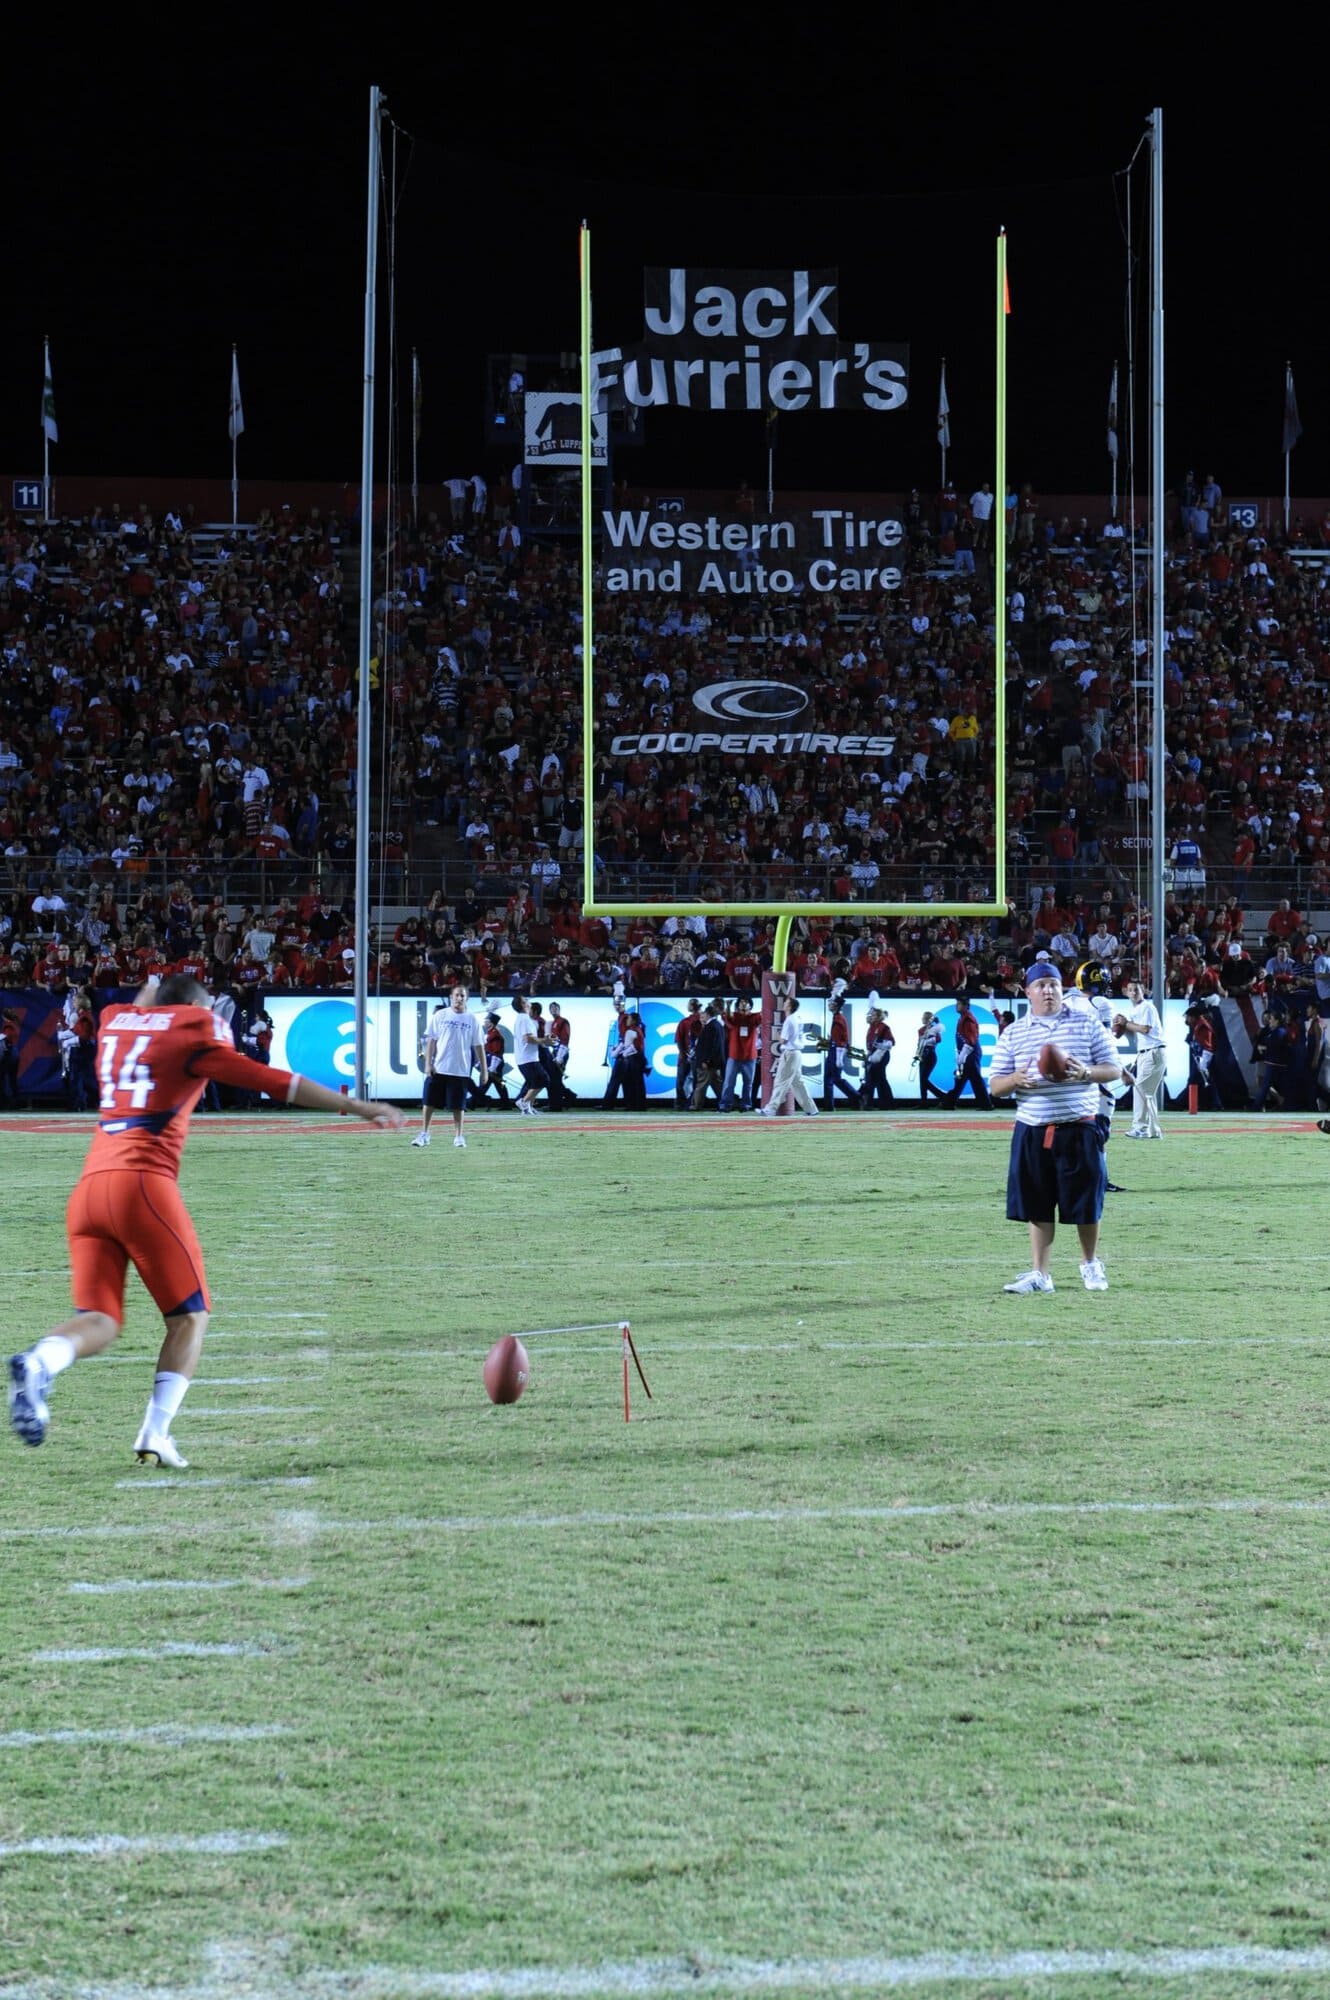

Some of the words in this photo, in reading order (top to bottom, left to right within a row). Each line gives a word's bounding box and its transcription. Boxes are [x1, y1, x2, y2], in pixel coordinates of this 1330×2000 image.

[644, 268, 837, 337] Jack
[588, 343, 908, 415] Furrier's
[17, 485, 39, 506] 11
[603, 510, 796, 551] Western
[812, 510, 903, 548] Tire
[1231, 509, 1256, 529] 13
[606, 560, 682, 593] and
[698, 562, 795, 594] Auto
[808, 559, 902, 592] Care
[611, 732, 896, 756] COOPERTIRES
[1122, 837, 1153, 850] SECTIO
[100, 1035, 156, 1109] 14
